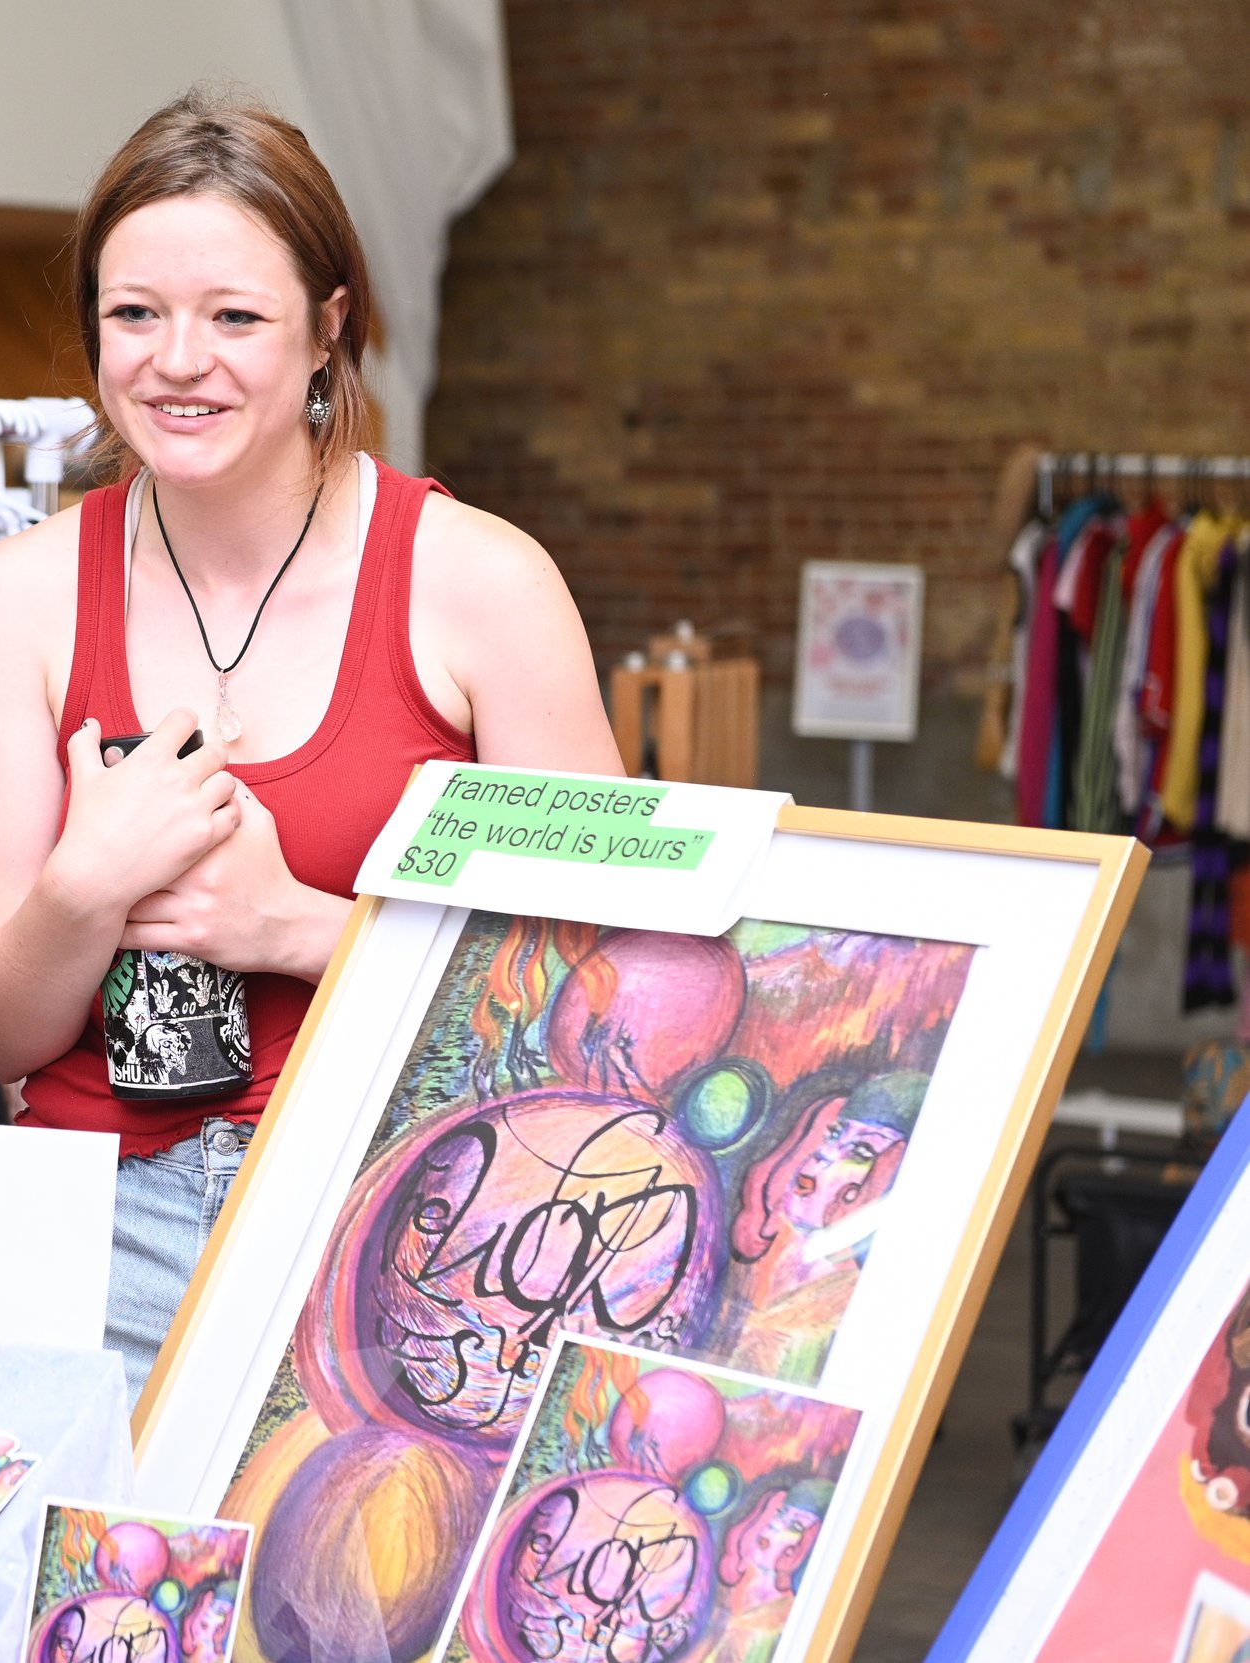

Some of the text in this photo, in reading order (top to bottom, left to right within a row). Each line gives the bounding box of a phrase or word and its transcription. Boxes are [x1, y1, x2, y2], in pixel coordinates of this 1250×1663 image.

[442, 773, 660, 816] framed posters
[427, 810, 478, 840] “the
[486, 823, 569, 851] world
[571, 826, 598, 854] is
[397, 845, 457, 877] $30
